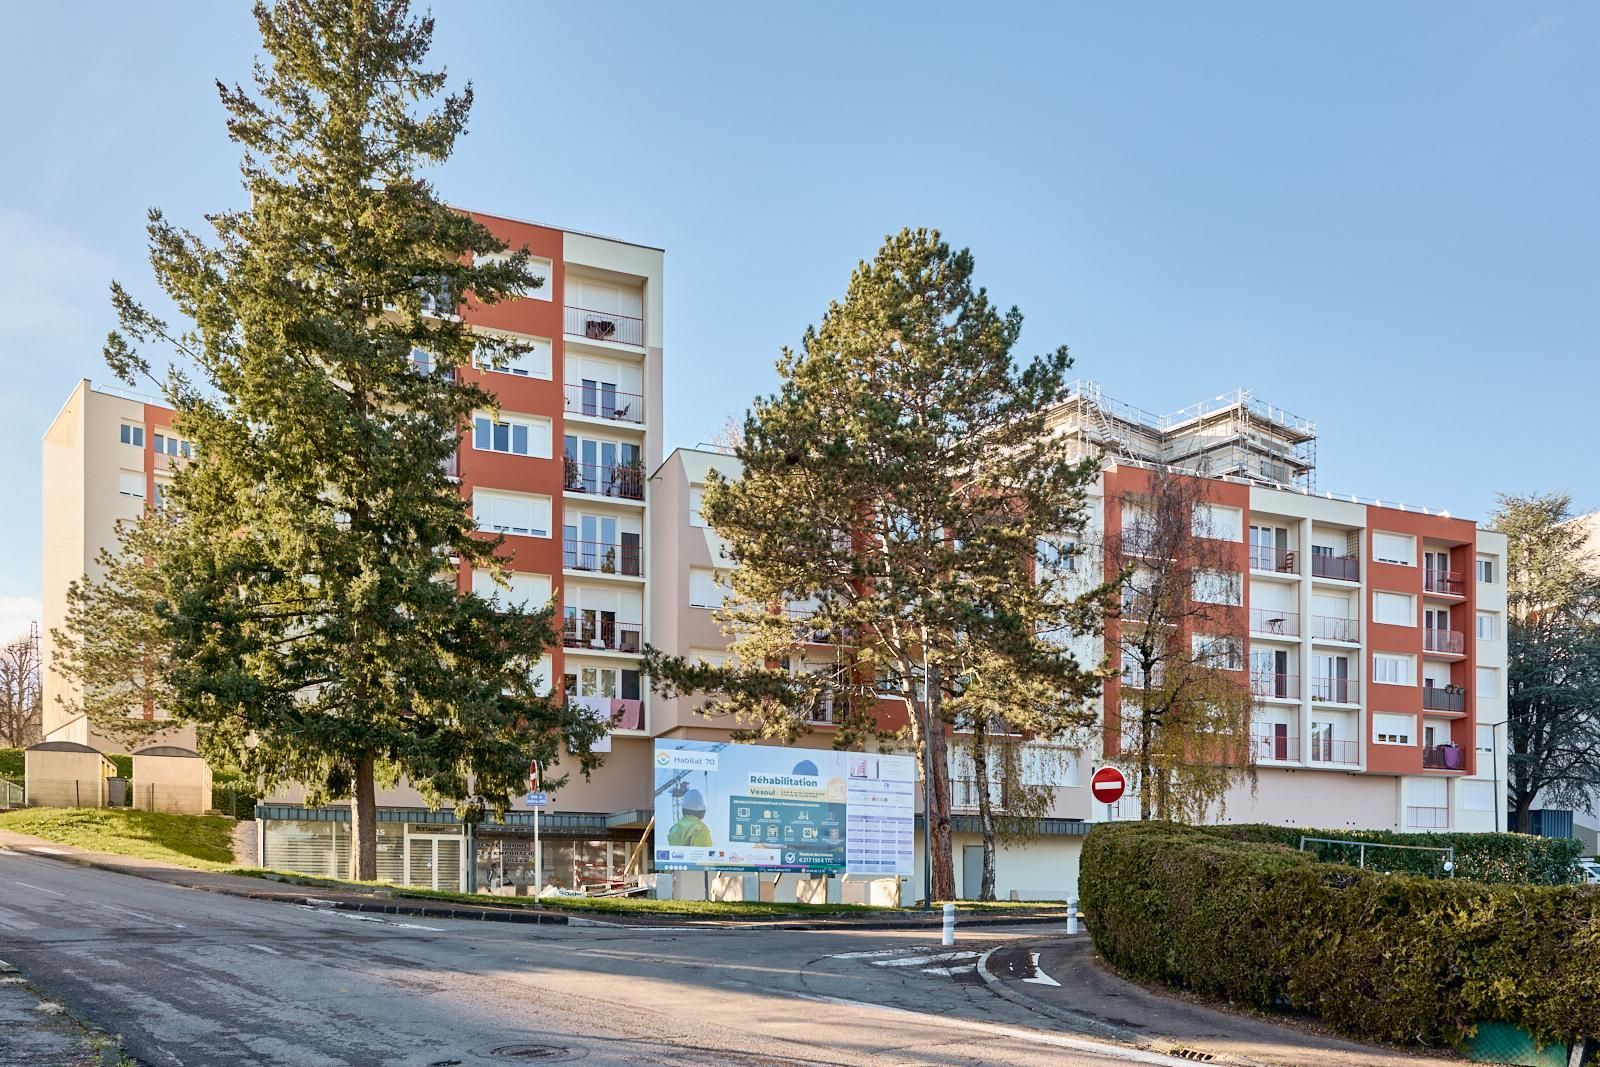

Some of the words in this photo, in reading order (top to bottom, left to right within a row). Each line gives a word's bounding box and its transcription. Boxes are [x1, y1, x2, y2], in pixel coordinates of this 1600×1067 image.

[674, 756, 702, 765] Habitat
[705, 758, 715, 766] 70
[750, 775, 818, 787] Réhabilitation
[750, 788, 775, 796] Vesoul
